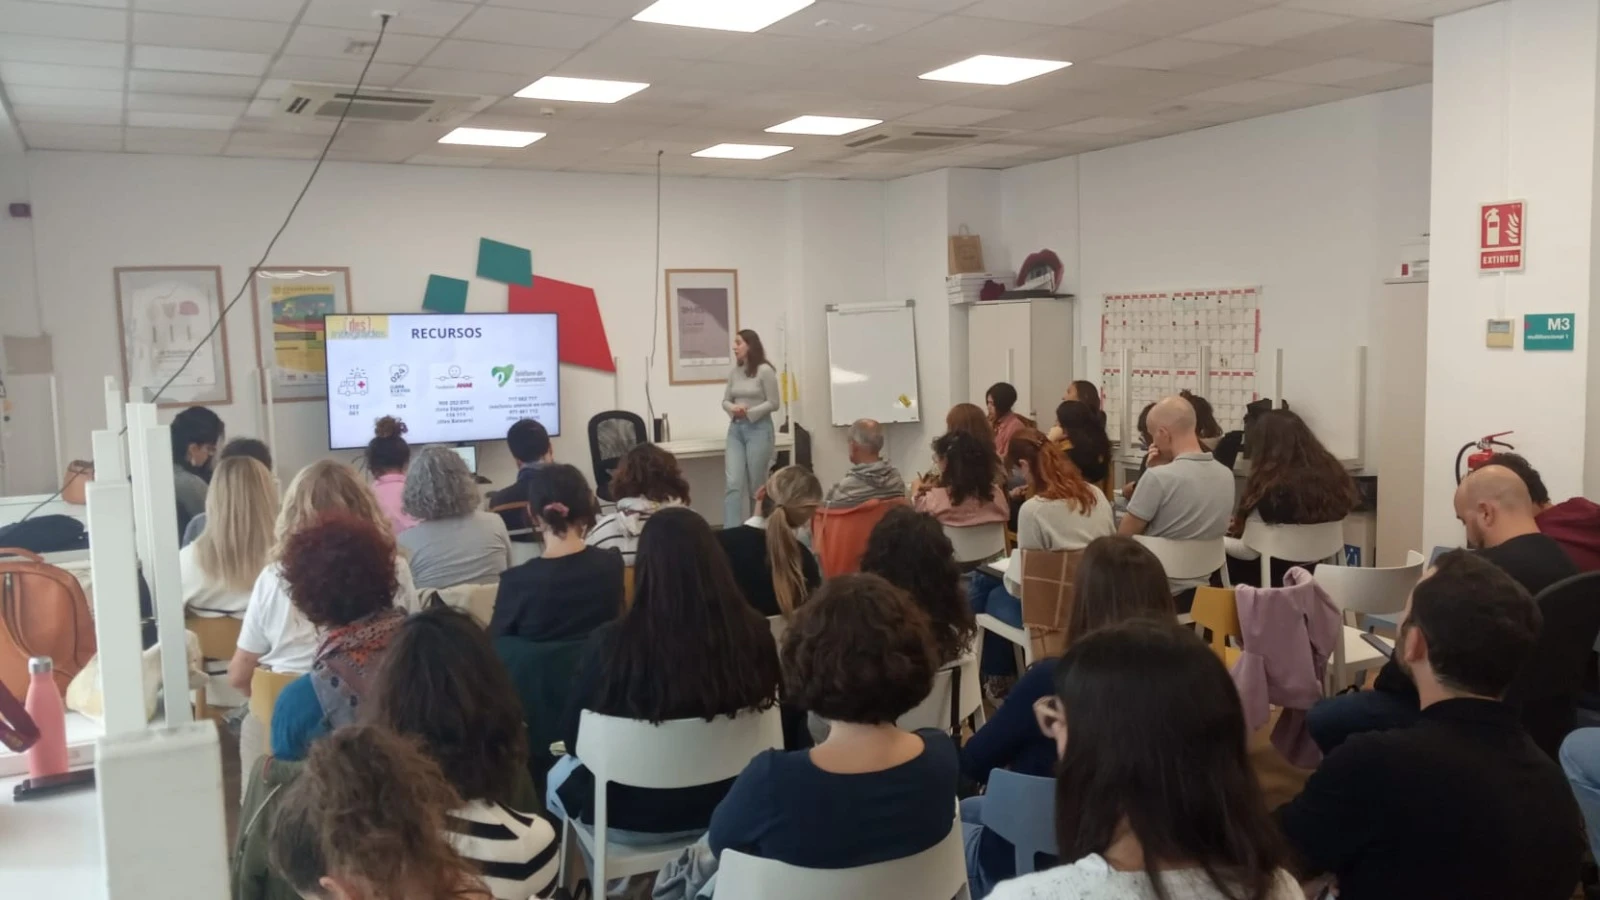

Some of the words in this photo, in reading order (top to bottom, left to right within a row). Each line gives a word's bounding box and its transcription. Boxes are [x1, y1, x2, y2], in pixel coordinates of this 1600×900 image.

[1483, 255, 1519, 264] EXTINTOR
[1548, 317, 1570, 331] M3
[411, 327, 482, 339] RECURSOS
